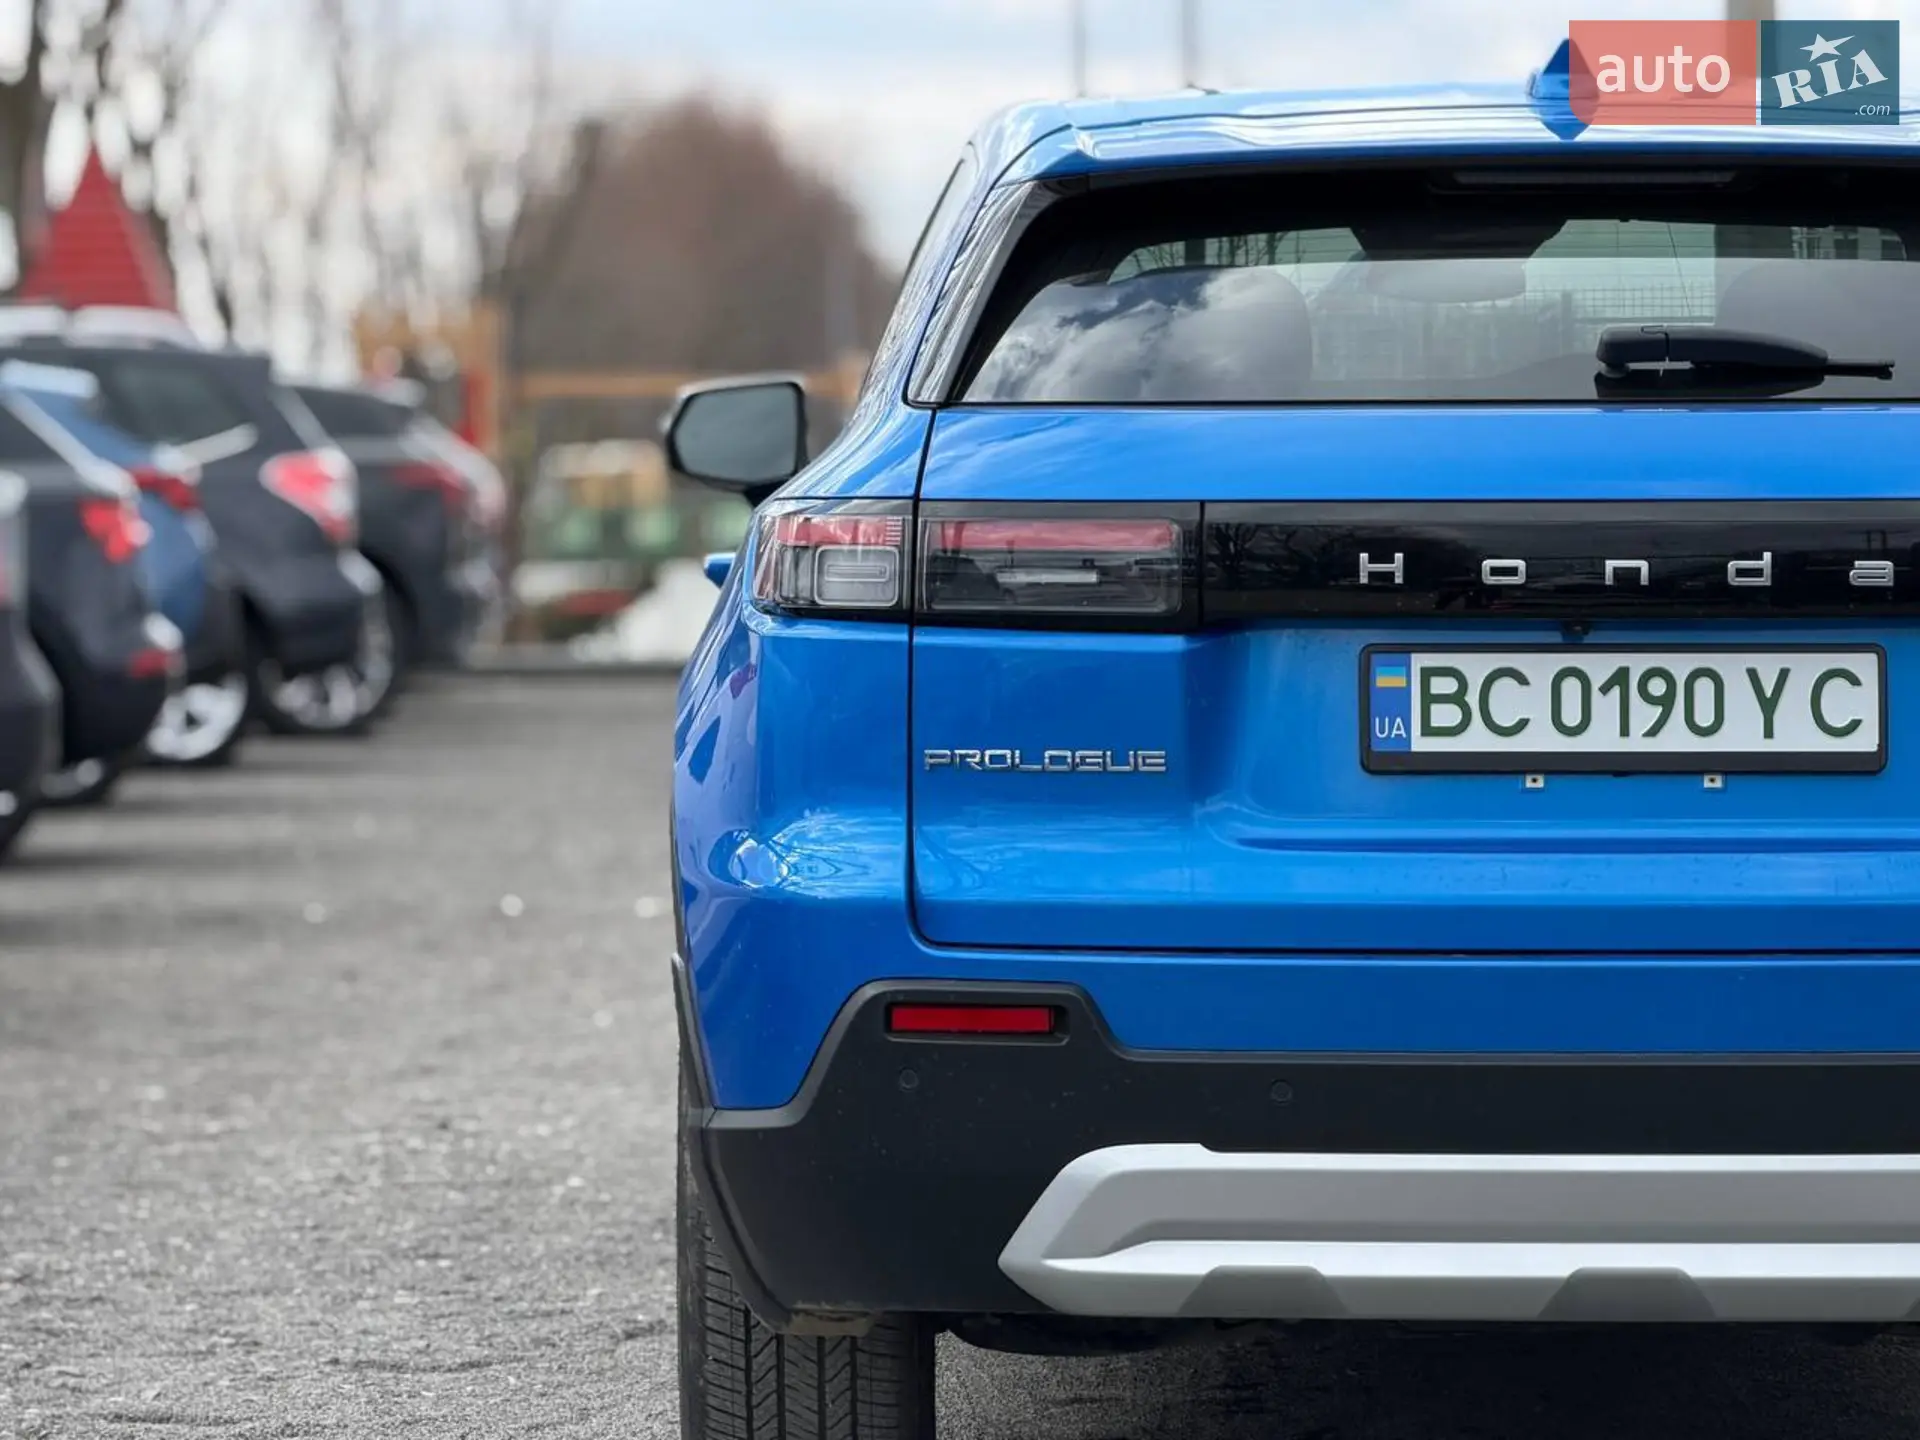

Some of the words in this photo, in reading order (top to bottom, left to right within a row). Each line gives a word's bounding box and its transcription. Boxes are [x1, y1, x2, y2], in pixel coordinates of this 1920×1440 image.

[1420, 665, 1531, 738] BC
[1550, 665, 1725, 738] 0190
[1374, 716, 1407, 739] UA
[923, 748, 1167, 773] PROLOGUE
